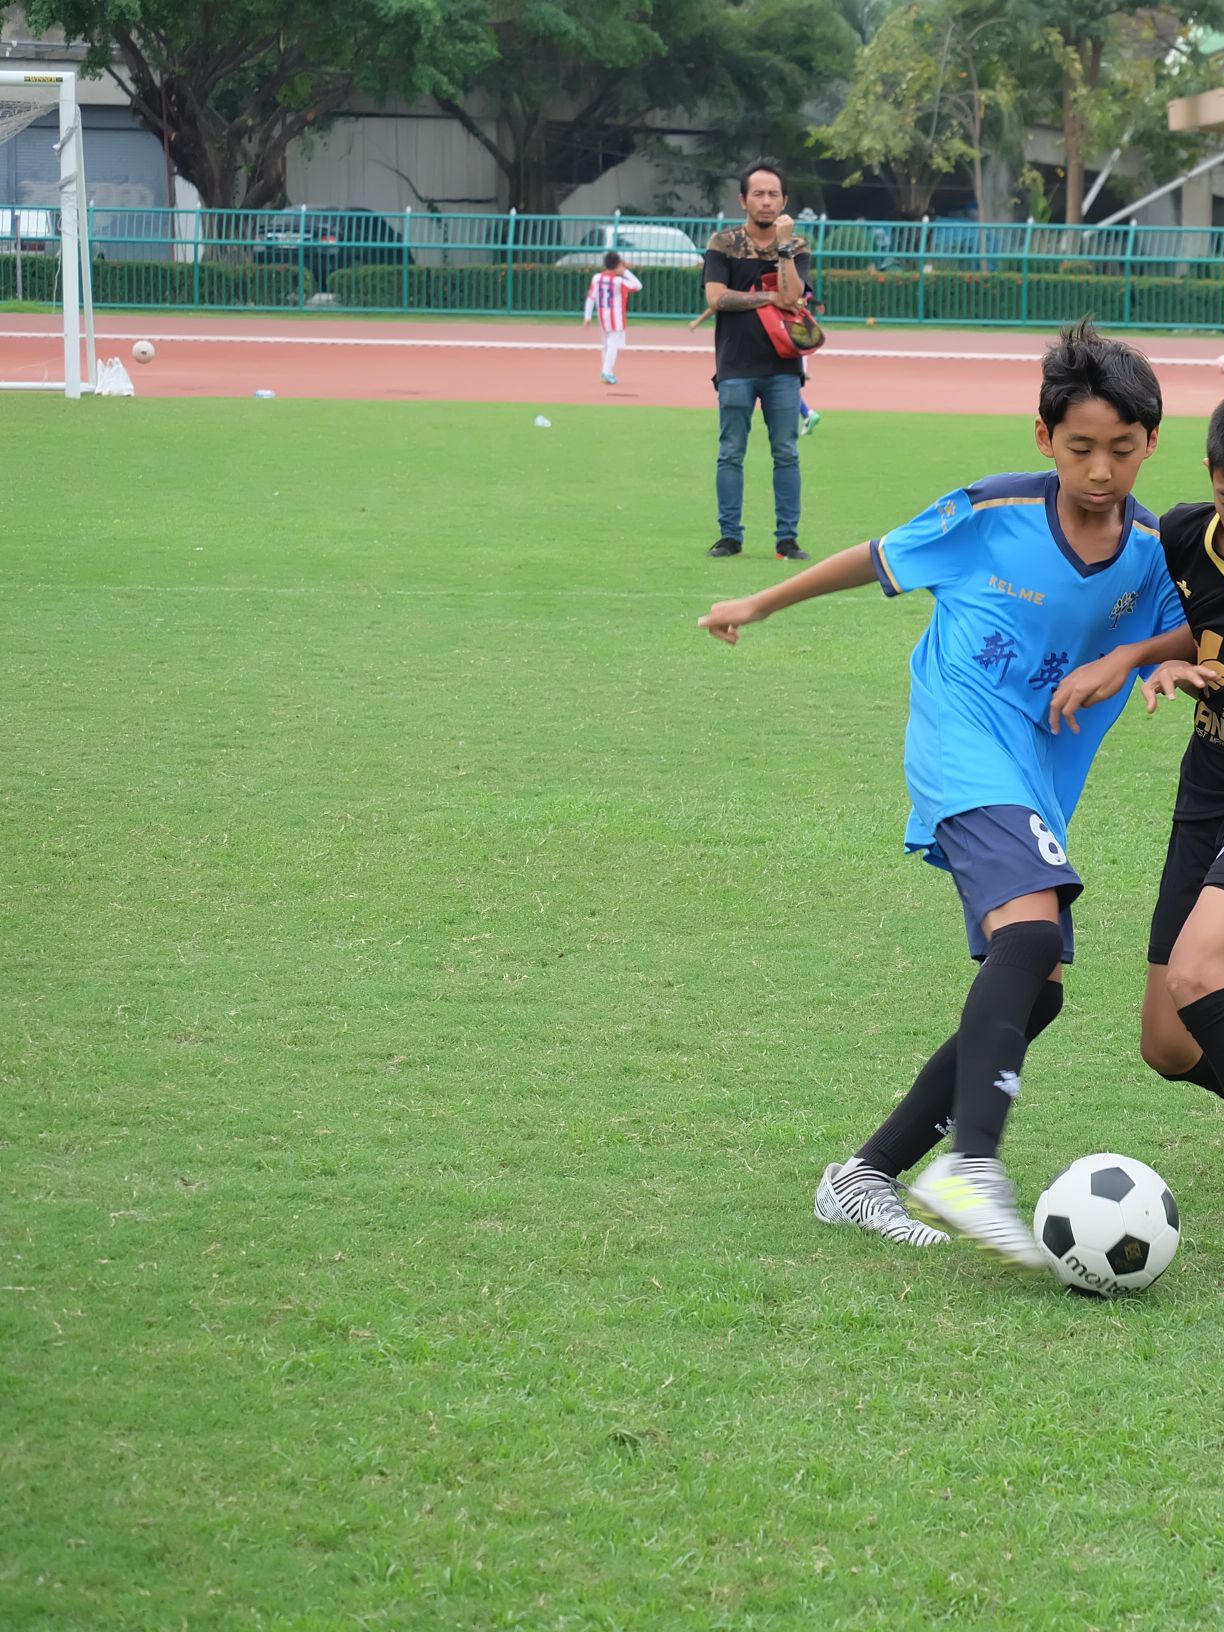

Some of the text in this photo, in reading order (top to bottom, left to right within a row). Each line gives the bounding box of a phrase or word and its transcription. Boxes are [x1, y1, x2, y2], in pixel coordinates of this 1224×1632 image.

[988, 574, 1046, 606] KELME
[971, 630, 1105, 694] 新英
[1029, 813, 1067, 866] 8
